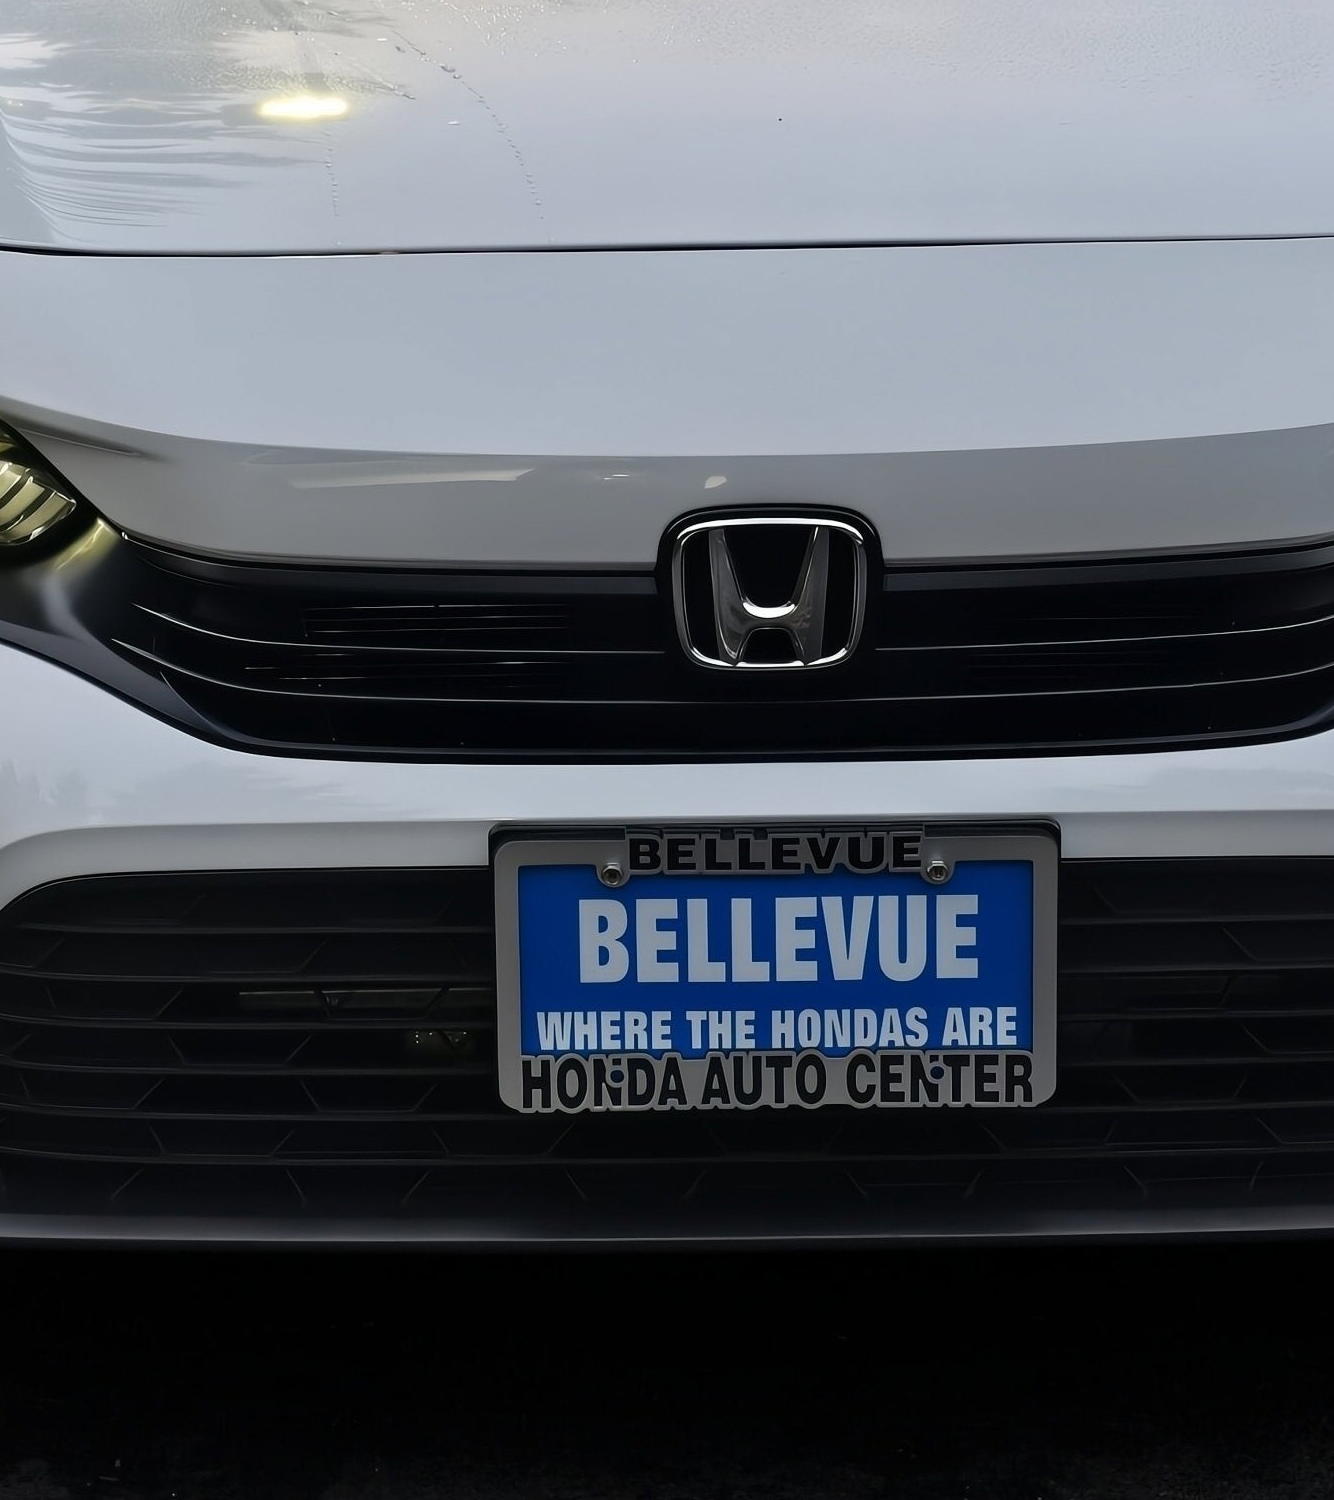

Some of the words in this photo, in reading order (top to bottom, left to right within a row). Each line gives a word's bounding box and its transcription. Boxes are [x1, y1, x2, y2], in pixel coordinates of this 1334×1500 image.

[628, 836, 923, 872] BELLEVUE
[578, 894, 979, 983] BELLEVUE
[536, 1010, 672, 1050] WHERE
[685, 1010, 756, 1049] THE
[771, 1006, 929, 1049] HONDAS
[941, 1006, 1018, 1047] ARE
[522, 1055, 688, 1109] HONDA
[703, 1054, 827, 1106] AUTO
[845, 1052, 1034, 1105] CENTER
